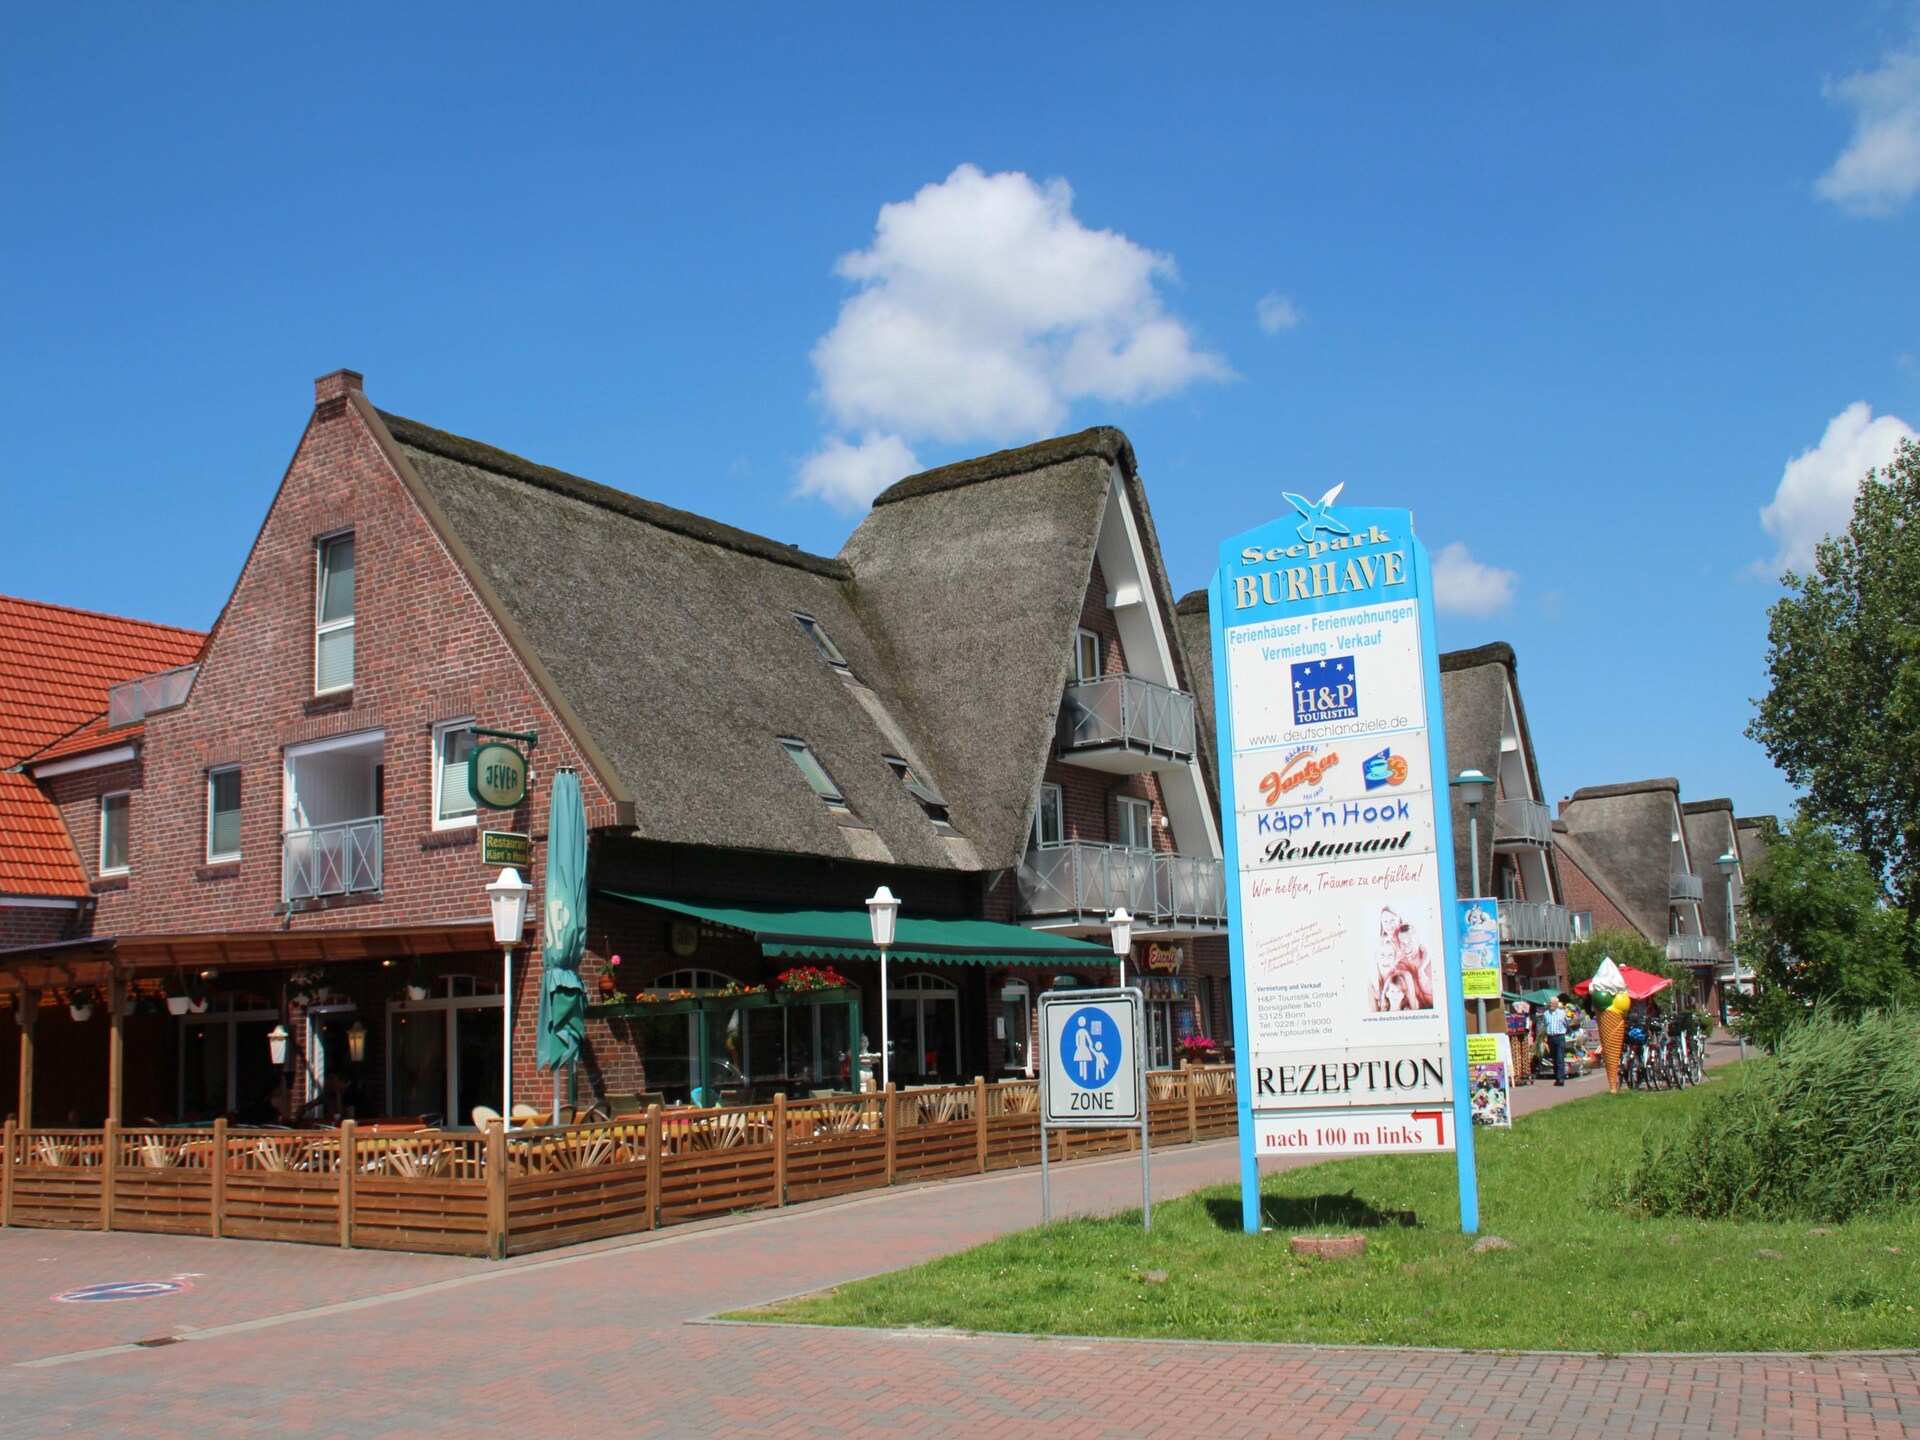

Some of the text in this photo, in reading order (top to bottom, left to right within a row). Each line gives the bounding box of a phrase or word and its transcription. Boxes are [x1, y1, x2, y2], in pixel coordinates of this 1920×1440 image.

[1241, 525, 1390, 567] Seepark
[1234, 550, 1407, 610] BURHAVE
[1230, 623, 1301, 645] Ferienhäuser
[1312, 605, 1414, 632] Ferienwohnungen
[1261, 641, 1327, 662] Vermietung
[1336, 630, 1382, 651] Verkauf
[1296, 684, 1354, 714] H&P
[1297, 707, 1356, 723] TOURISTIK
[486, 764, 517, 790] JEVER
[1259, 752, 1339, 806] Jantzen
[1343, 799, 1409, 825] Hook
[1260, 831, 1412, 864] Restaurant
[1252, 863, 1423, 899] Wir helfen, Träume zu erfüllen!
[1258, 991, 1338, 1003] H&P Touristik GmbH
[1258, 1003, 1301, 1012] Borsigallee
[1259, 1011, 1306, 1020] 53125 Bonn
[1260, 1021, 1273, 1029] Tel.
[1274, 1020, 1295, 1028] 0228
[1302, 1017, 1332, 1026] 919000
[1260, 1027, 1333, 1038] www.hptouristik.de
[1256, 1057, 1444, 1096] REZEPTION
[1070, 1092, 1114, 1110] ZONE
[1266, 1126, 1422, 1147] nach 100 m links
